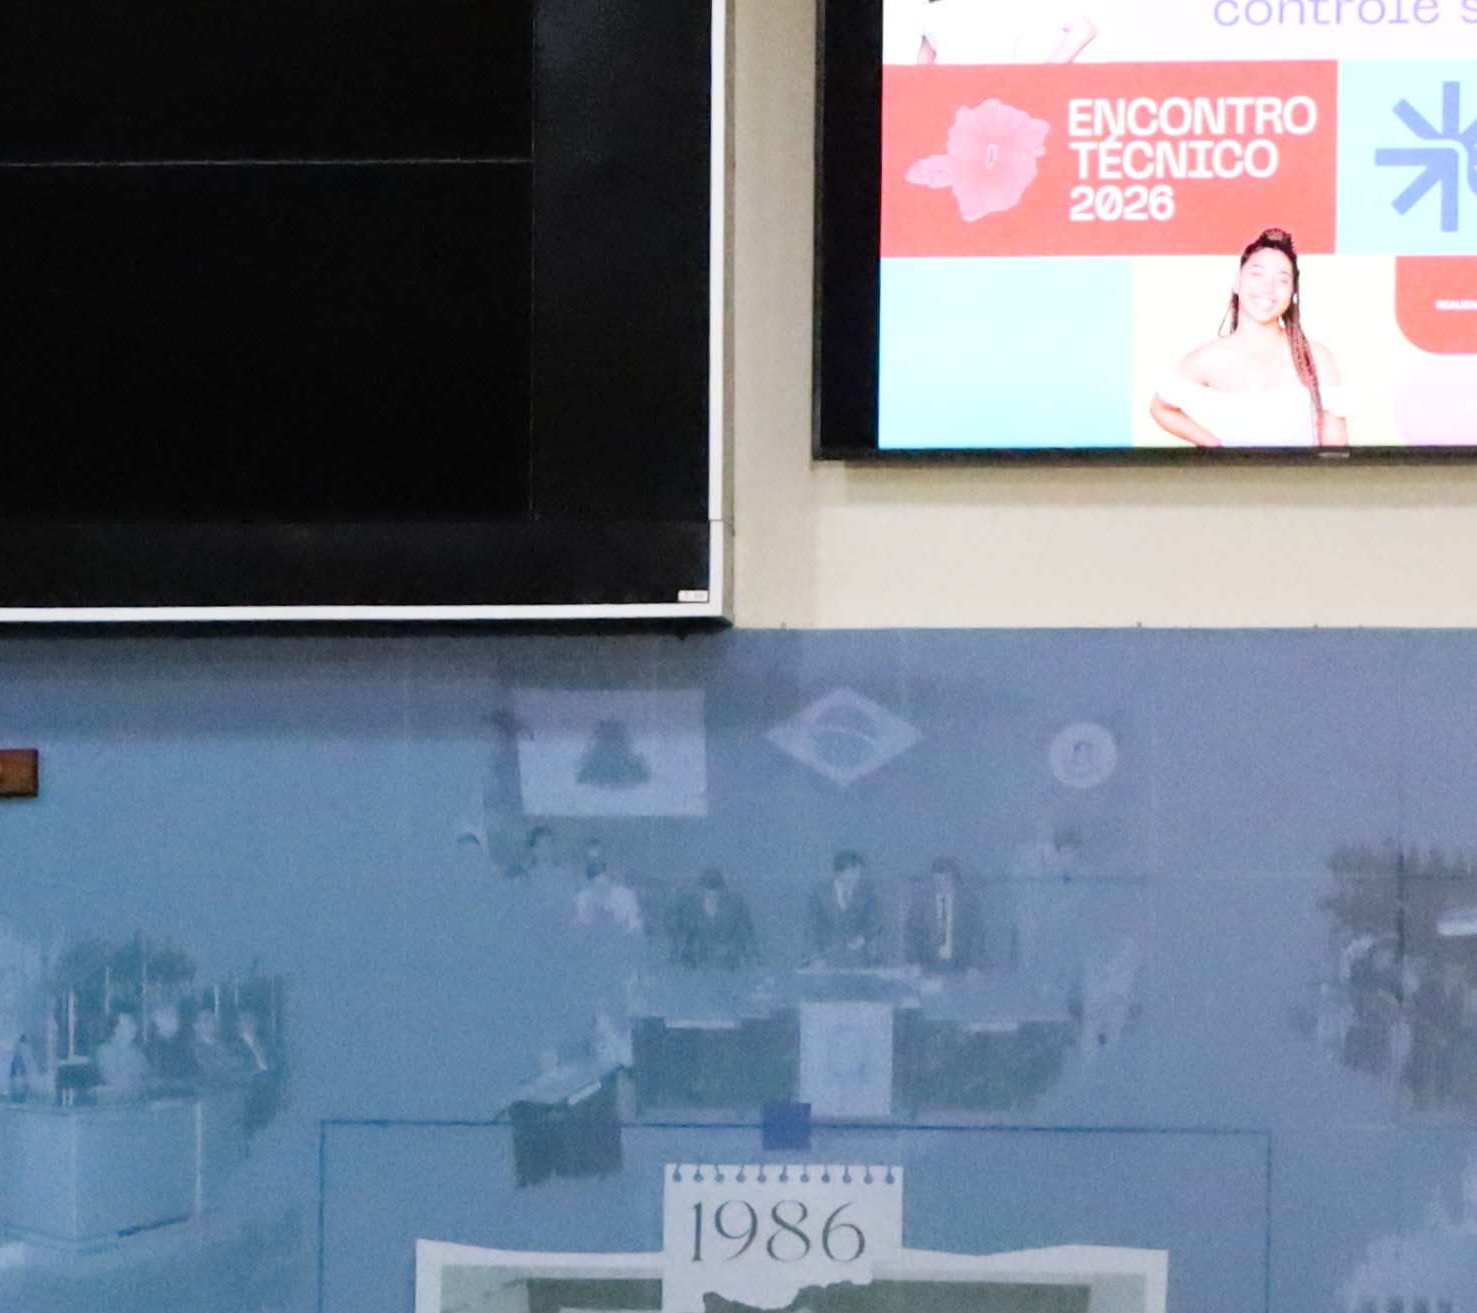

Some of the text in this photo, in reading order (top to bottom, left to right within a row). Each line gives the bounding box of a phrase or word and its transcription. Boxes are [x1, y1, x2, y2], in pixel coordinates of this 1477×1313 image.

[1068, 95, 1317, 136] ENCONTRO
[1068, 134, 1279, 179] TÉCNICO
[1068, 184, 1175, 221] 2026
[691, 1199, 866, 1263] 1986
